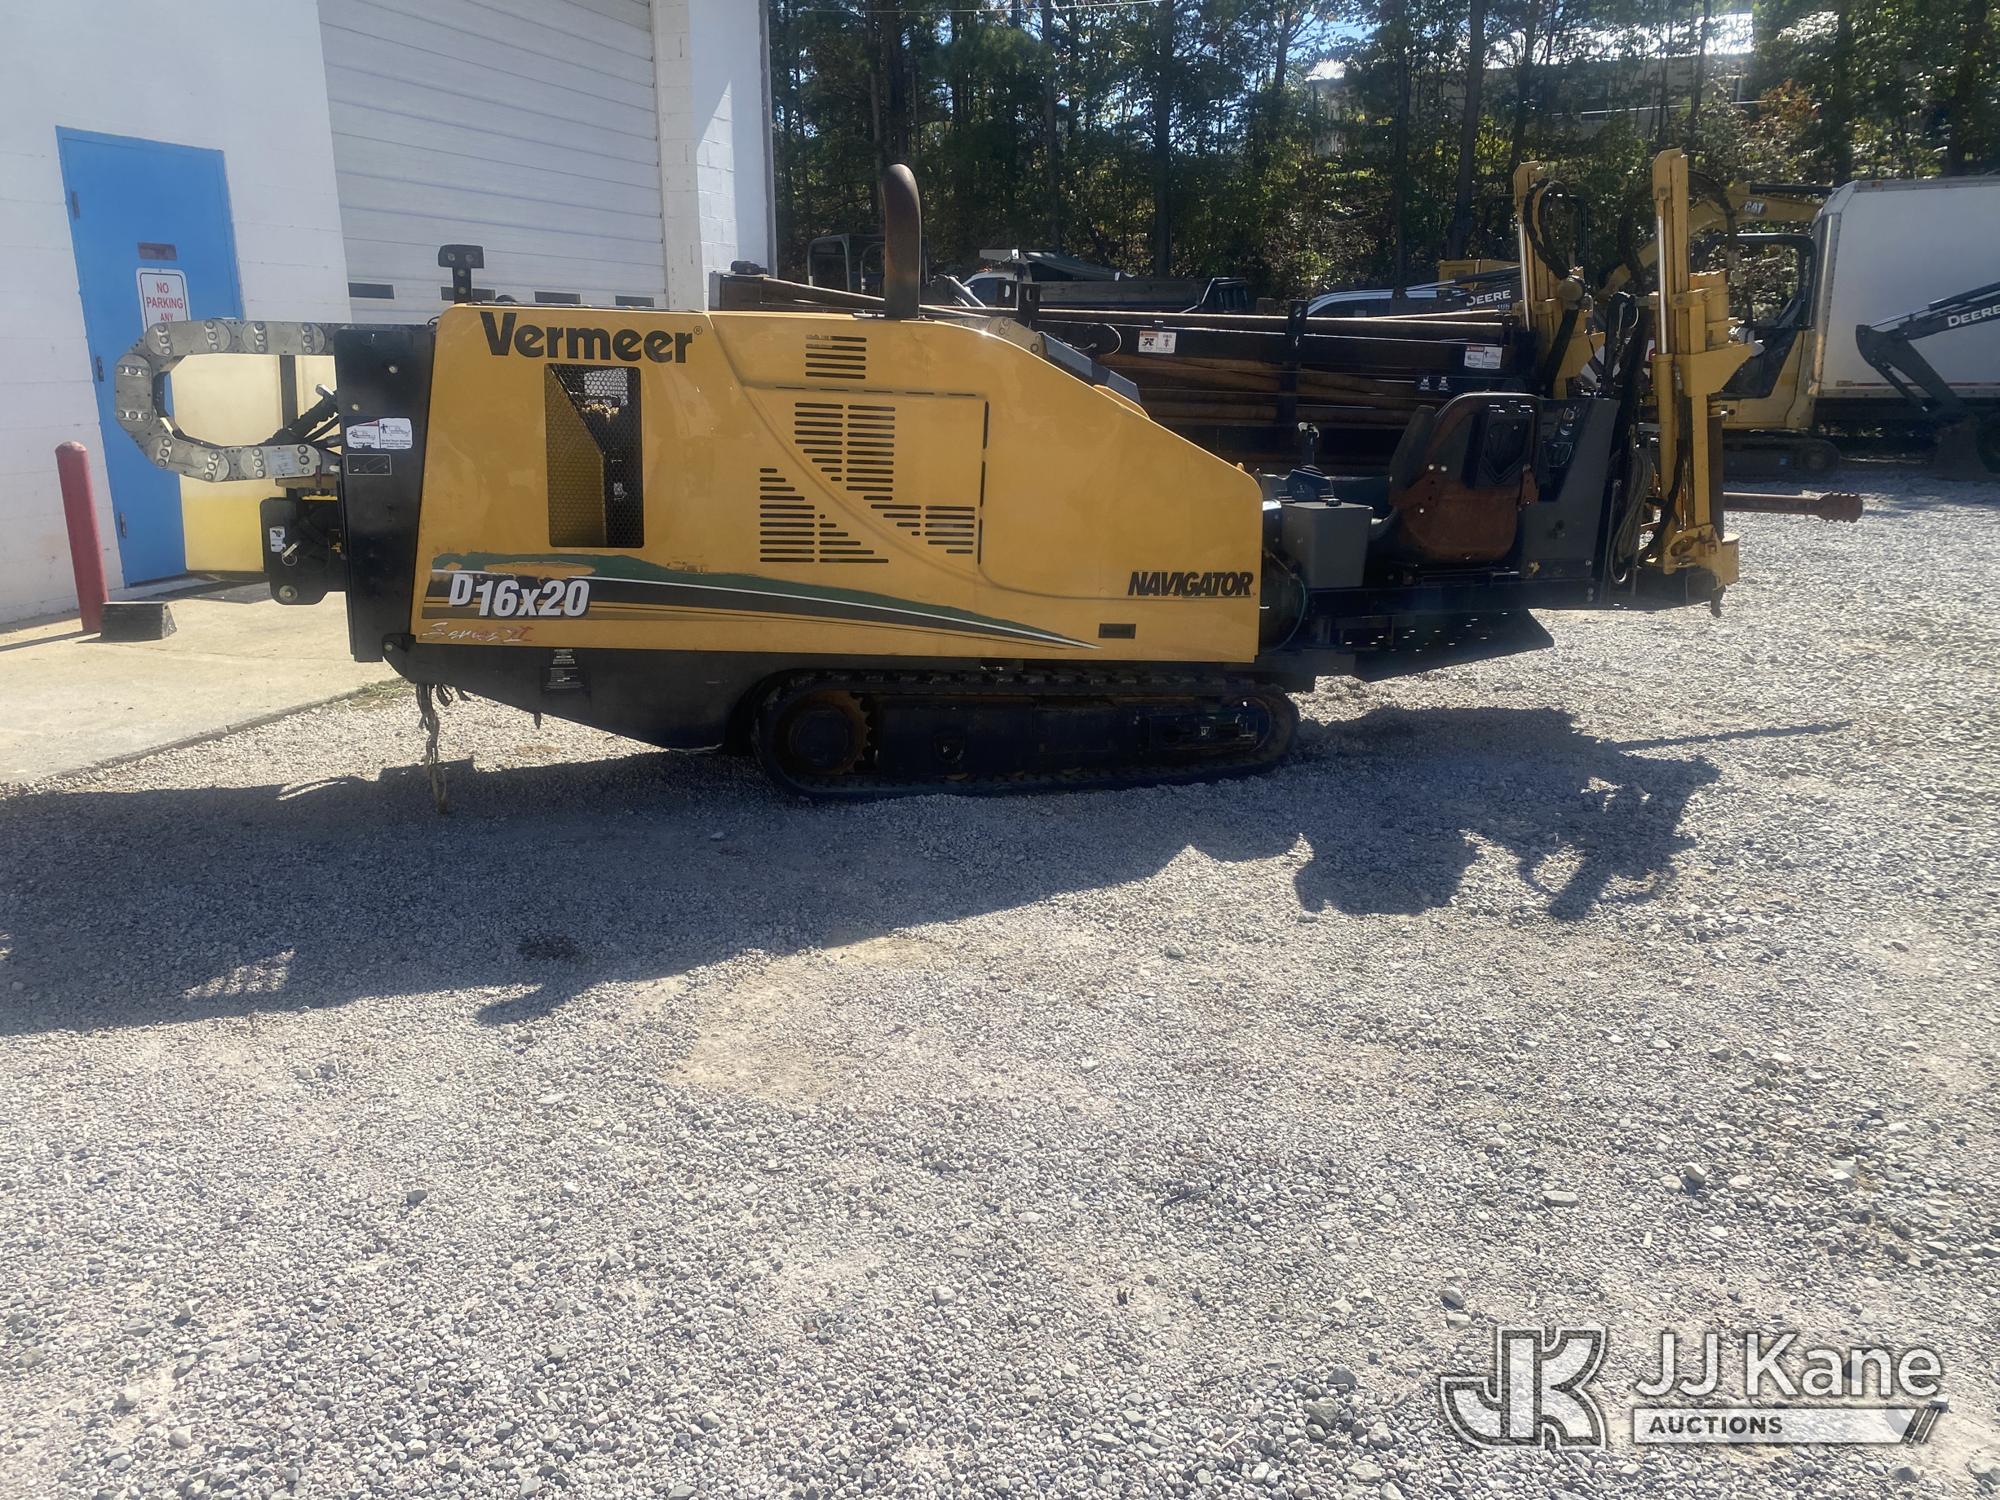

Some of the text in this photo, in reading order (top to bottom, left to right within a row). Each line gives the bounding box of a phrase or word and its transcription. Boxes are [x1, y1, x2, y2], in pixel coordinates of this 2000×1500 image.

[1744, 200, 1764, 215] CAT
[156, 282, 169, 294] NO
[146, 296, 184, 309] PARKING
[1466, 289, 1511, 307] DEERE
[160, 312, 174, 321] ANY
[1947, 304, 2000, 327] DEERE
[479, 310, 694, 364] Vermeer
[1127, 571, 1254, 597] NAVIGATOR
[449, 573, 591, 617] D16x20
